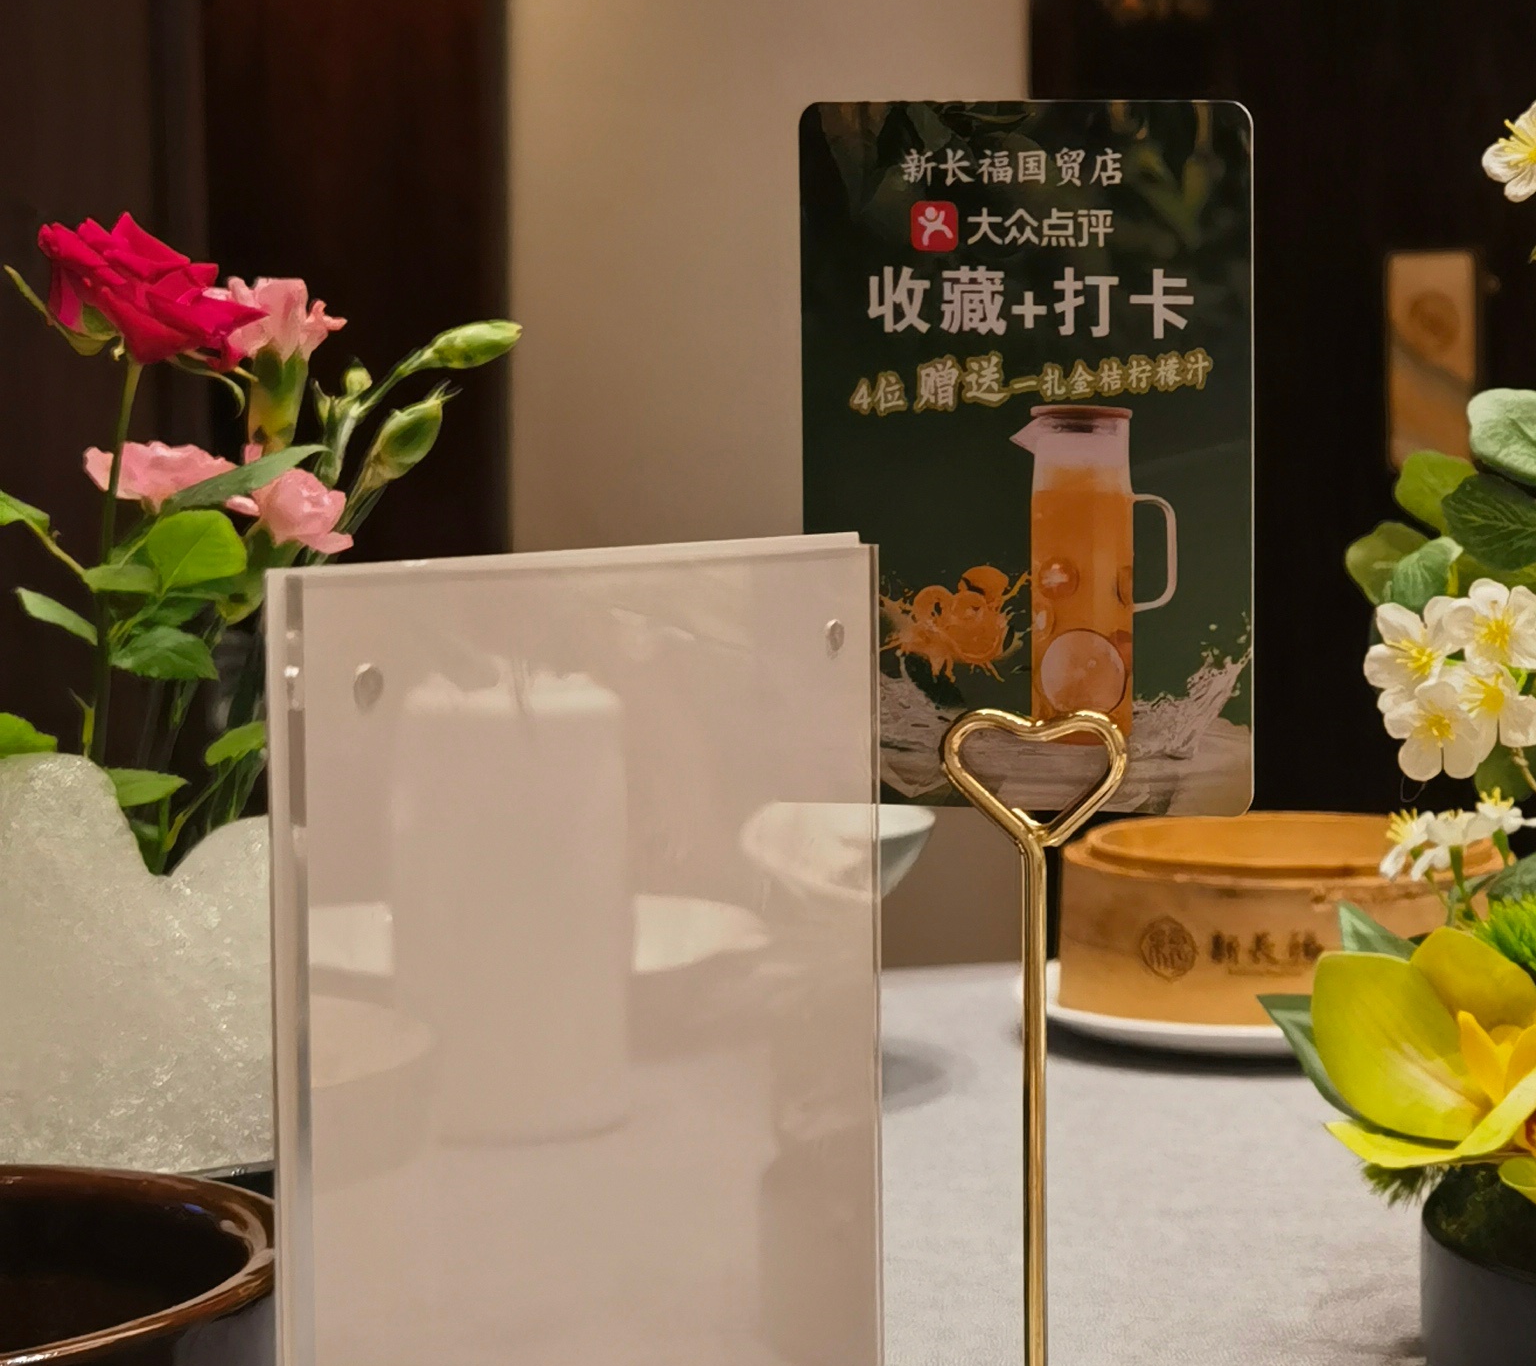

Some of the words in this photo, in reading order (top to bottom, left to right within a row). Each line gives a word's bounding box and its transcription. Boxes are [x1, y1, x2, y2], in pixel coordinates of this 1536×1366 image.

[900, 147, 1124, 187] 新长福国贸店
[967, 207, 1115, 247] 大众点评
[866, 265, 1195, 339] 收藏+打卡
